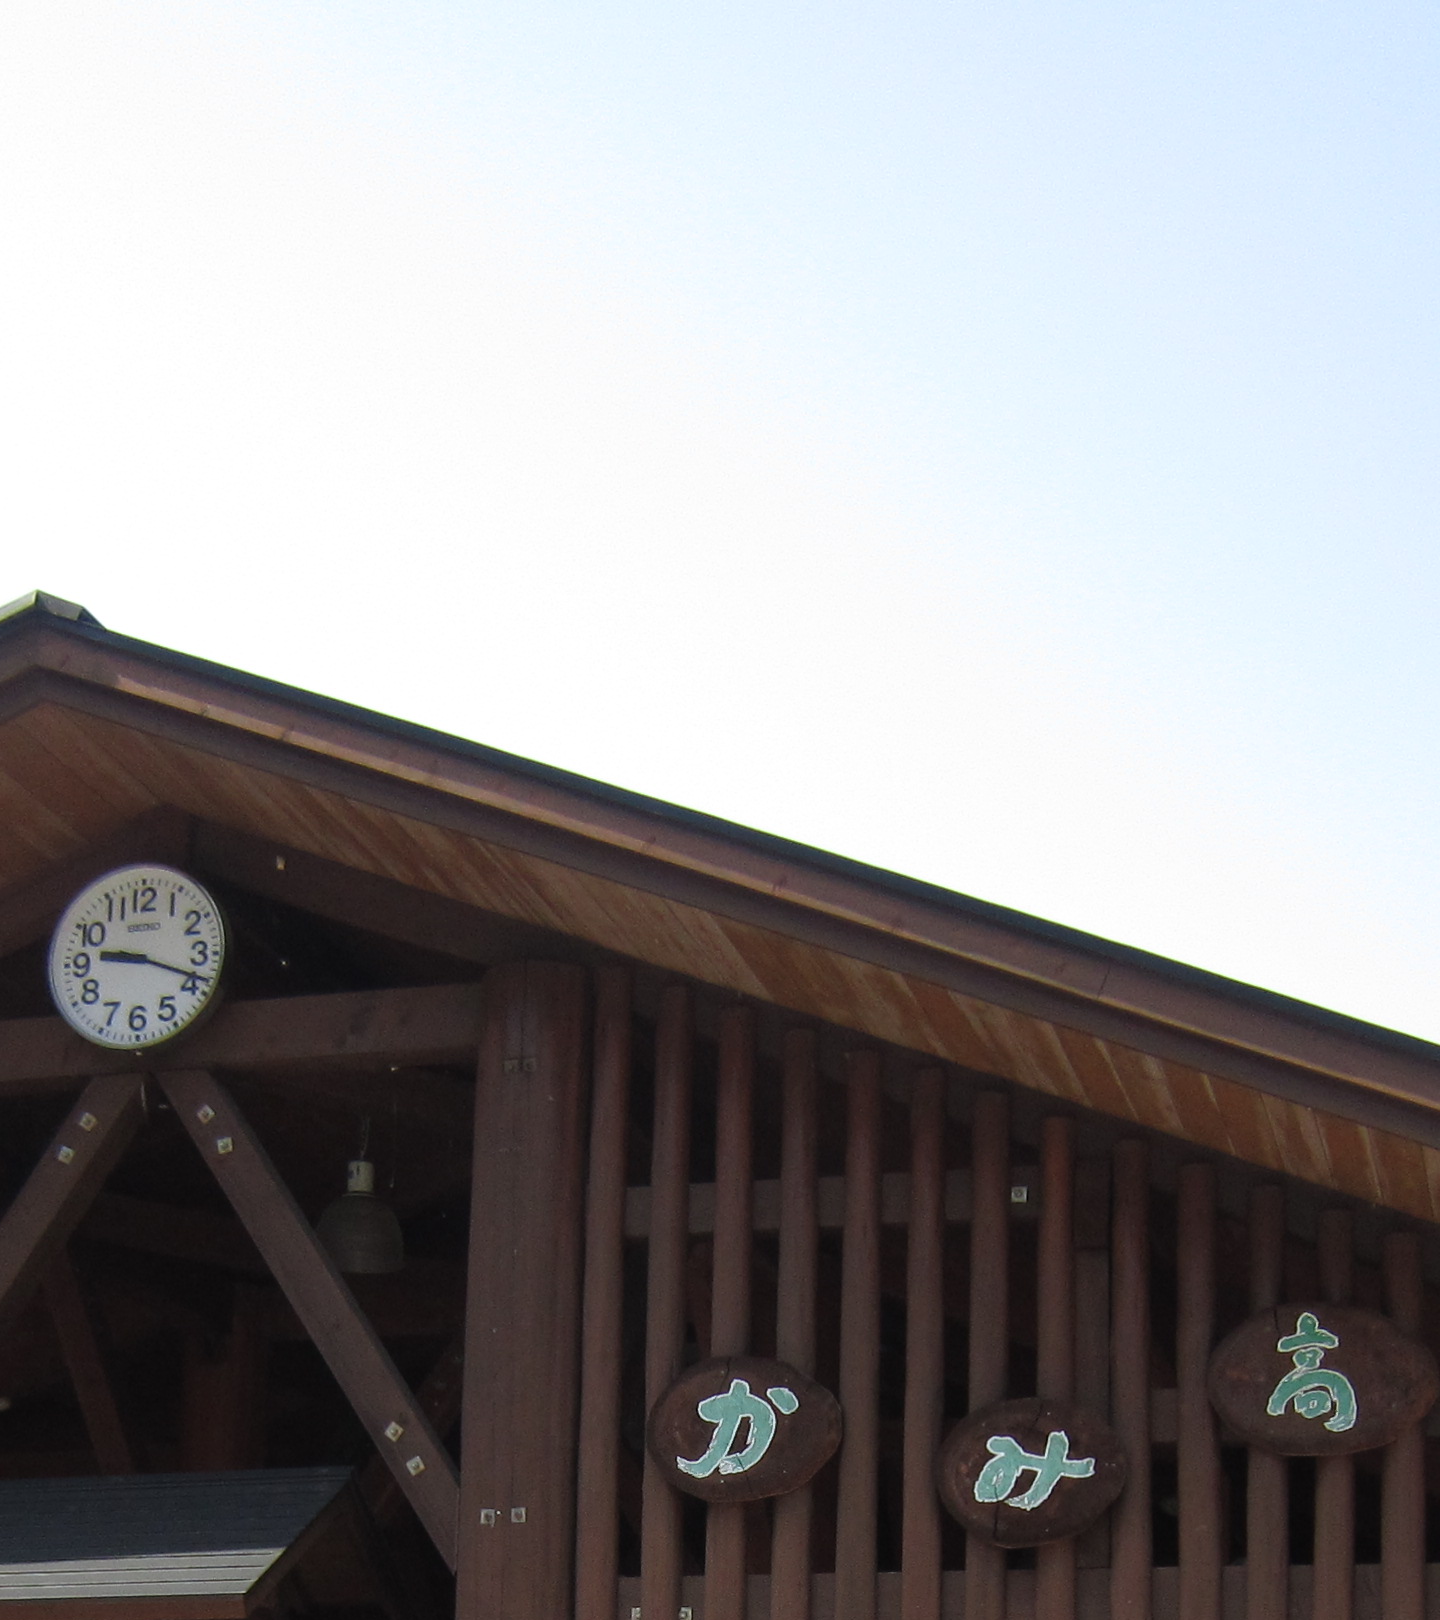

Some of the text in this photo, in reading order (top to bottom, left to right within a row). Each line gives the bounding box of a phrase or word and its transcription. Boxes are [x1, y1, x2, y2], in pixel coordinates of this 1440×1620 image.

[109, 896, 126, 922] 11
[132, 887, 157, 914] 12
[169, 892, 176, 917] 1
[82, 922, 106, 948] 10
[184, 910, 202, 936] 2
[72, 952, 91, 978] 9
[189, 940, 209, 967] 3
[81, 979, 100, 1006] 8
[181, 972, 200, 996] 4
[103, 1002, 122, 1027] 7
[128, 1005, 148, 1032] 6
[157, 996, 176, 1022] 5
